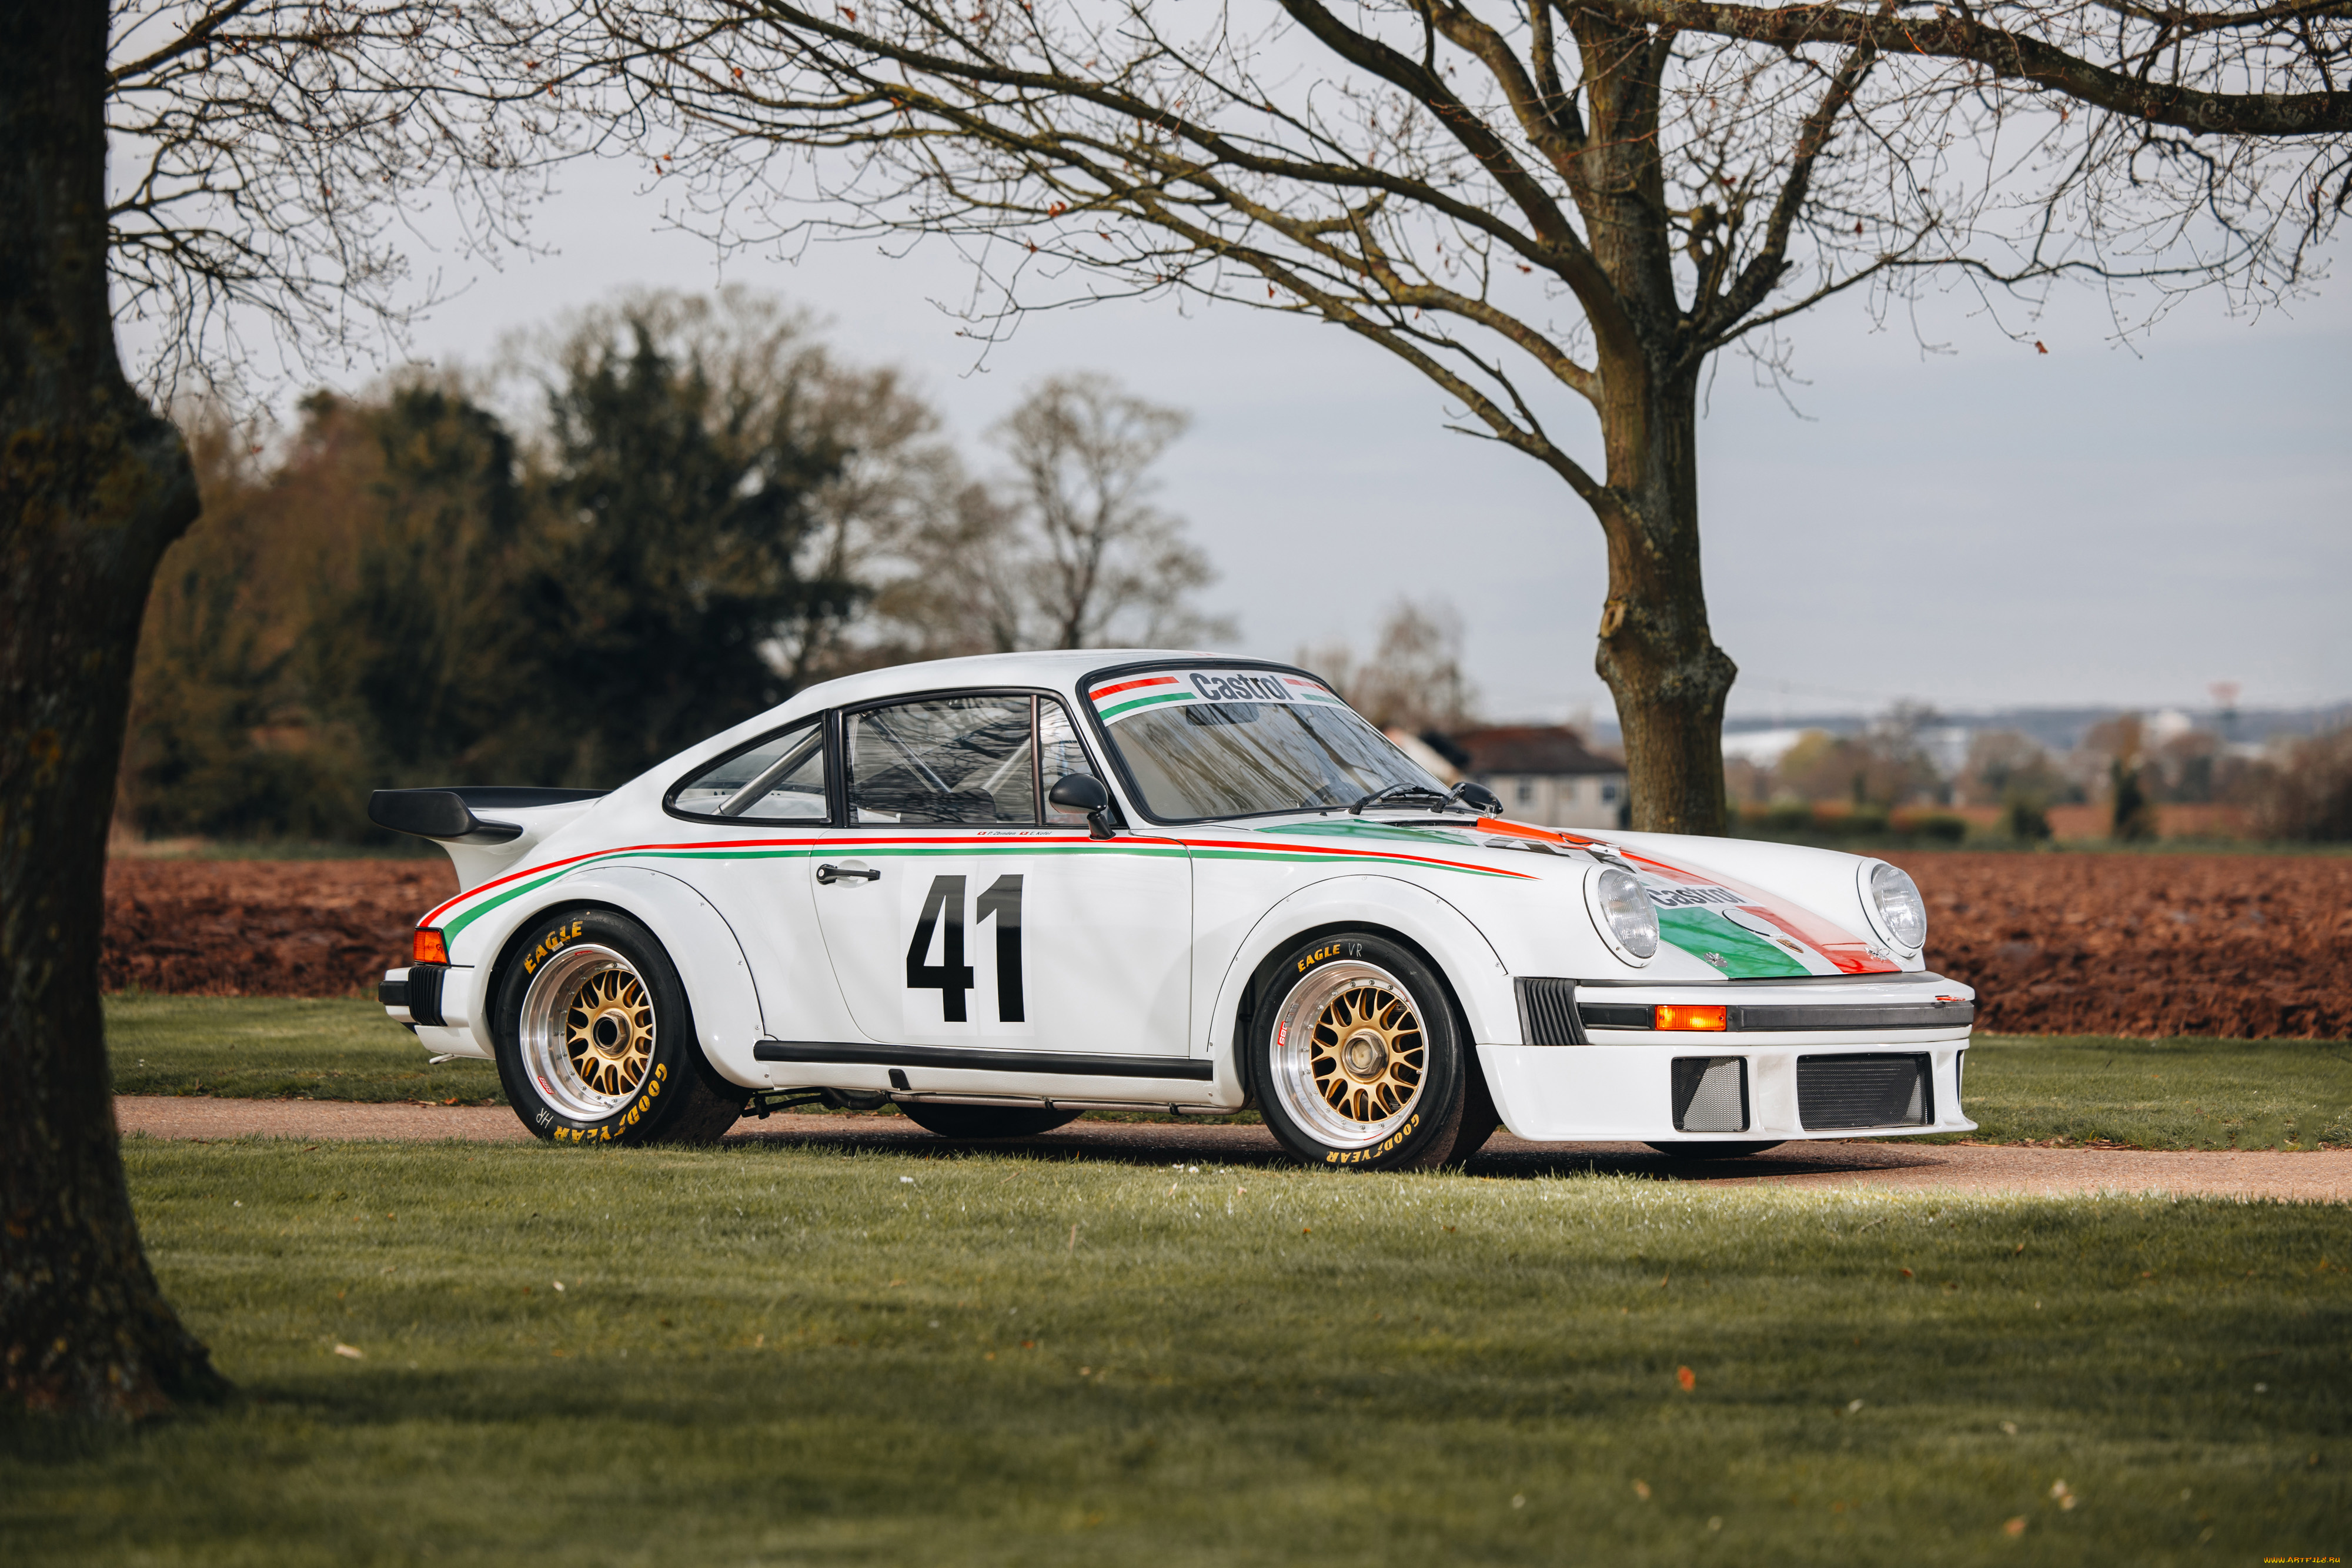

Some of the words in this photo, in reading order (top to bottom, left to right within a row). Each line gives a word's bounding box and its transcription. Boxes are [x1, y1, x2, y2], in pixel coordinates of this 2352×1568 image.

[1189, 673, 1295, 701] Castrol
[1646, 887, 1748, 906] Castrol
[523, 921, 583, 974] EAGLE
[906, 874, 1025, 1022] 41
[1298, 944, 1341, 972] EAGLE
[1348, 942, 1362, 957] VR
[539, 1076, 554, 1094] BBS
[536, 1108, 554, 1129] HR
[1326, 1114, 1419, 1164] GOODYEAR
